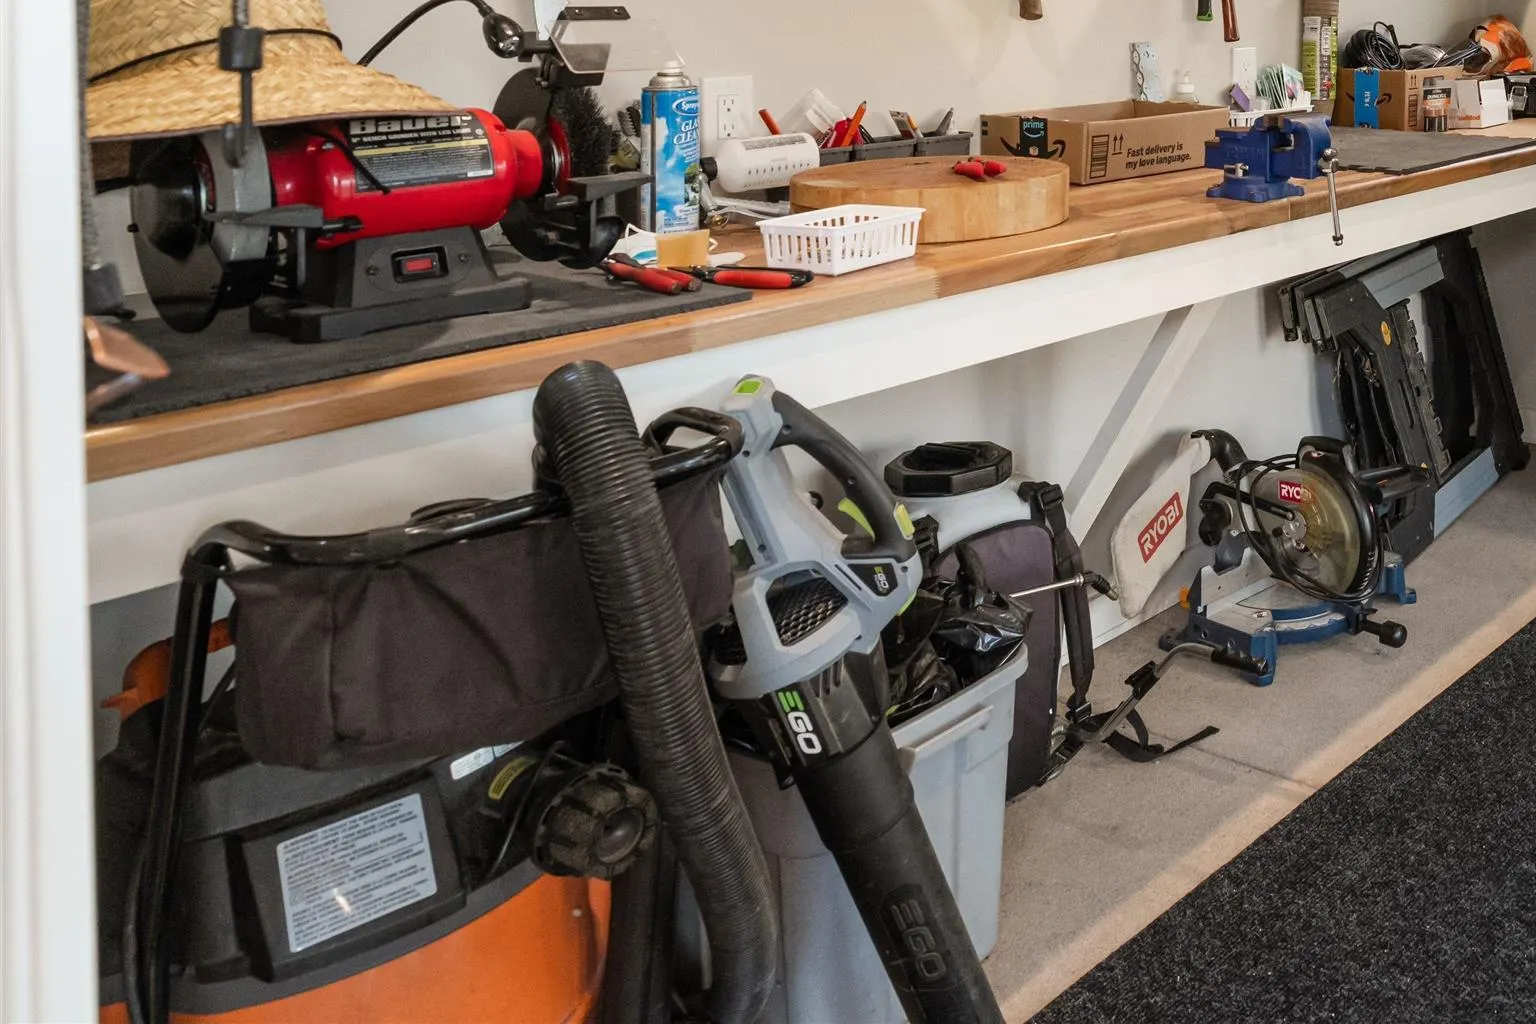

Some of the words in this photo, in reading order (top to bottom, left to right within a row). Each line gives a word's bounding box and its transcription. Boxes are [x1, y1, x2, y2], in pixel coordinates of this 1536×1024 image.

[1023, 120, 1045, 131] prime
[1125, 161, 1137, 170] my
[1138, 157, 1155, 168] love
[1155, 152, 1192, 167] language.
[1126, 146, 1144, 159] Fast
[1144, 143, 1175, 158] delivery
[1176, 142, 1183, 151] is
[1140, 498, 1181, 556] RYOBI
[778, 690, 823, 755] EGO
[889, 898, 946, 980] EGO
